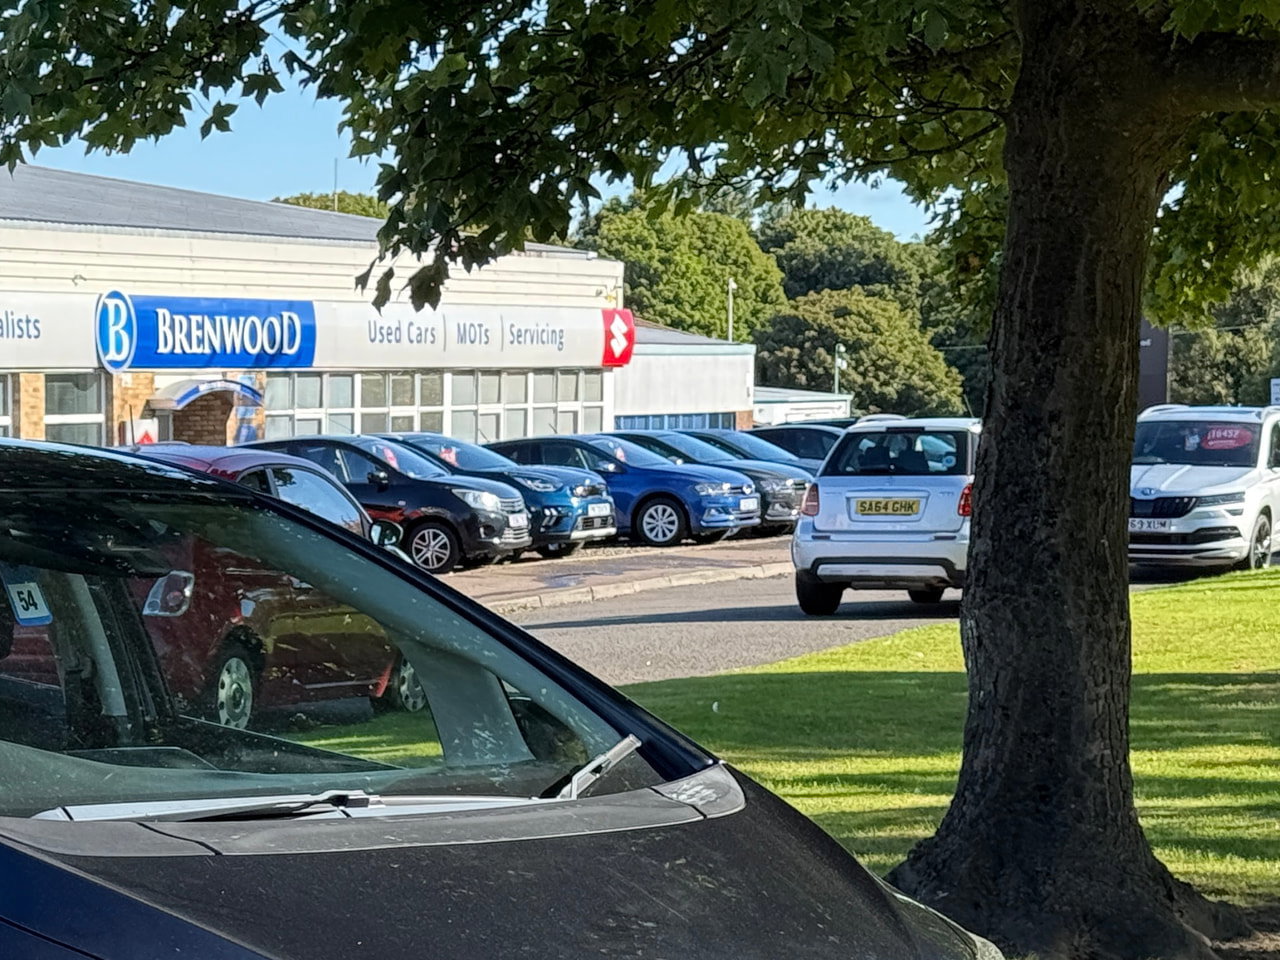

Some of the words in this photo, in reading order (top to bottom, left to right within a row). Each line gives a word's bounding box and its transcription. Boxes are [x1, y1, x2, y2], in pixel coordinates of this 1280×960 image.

[155, 308, 302, 355] BRENWOOD
[367, 319, 402, 344] Used
[407, 321, 437, 345] Cars
[456, 322, 490, 345] MOTs
[508, 322, 565, 351] Servicing
[859, 500, 889, 513] SA64
[891, 500, 917, 513] GHK
[16, 589, 39, 612] 54
